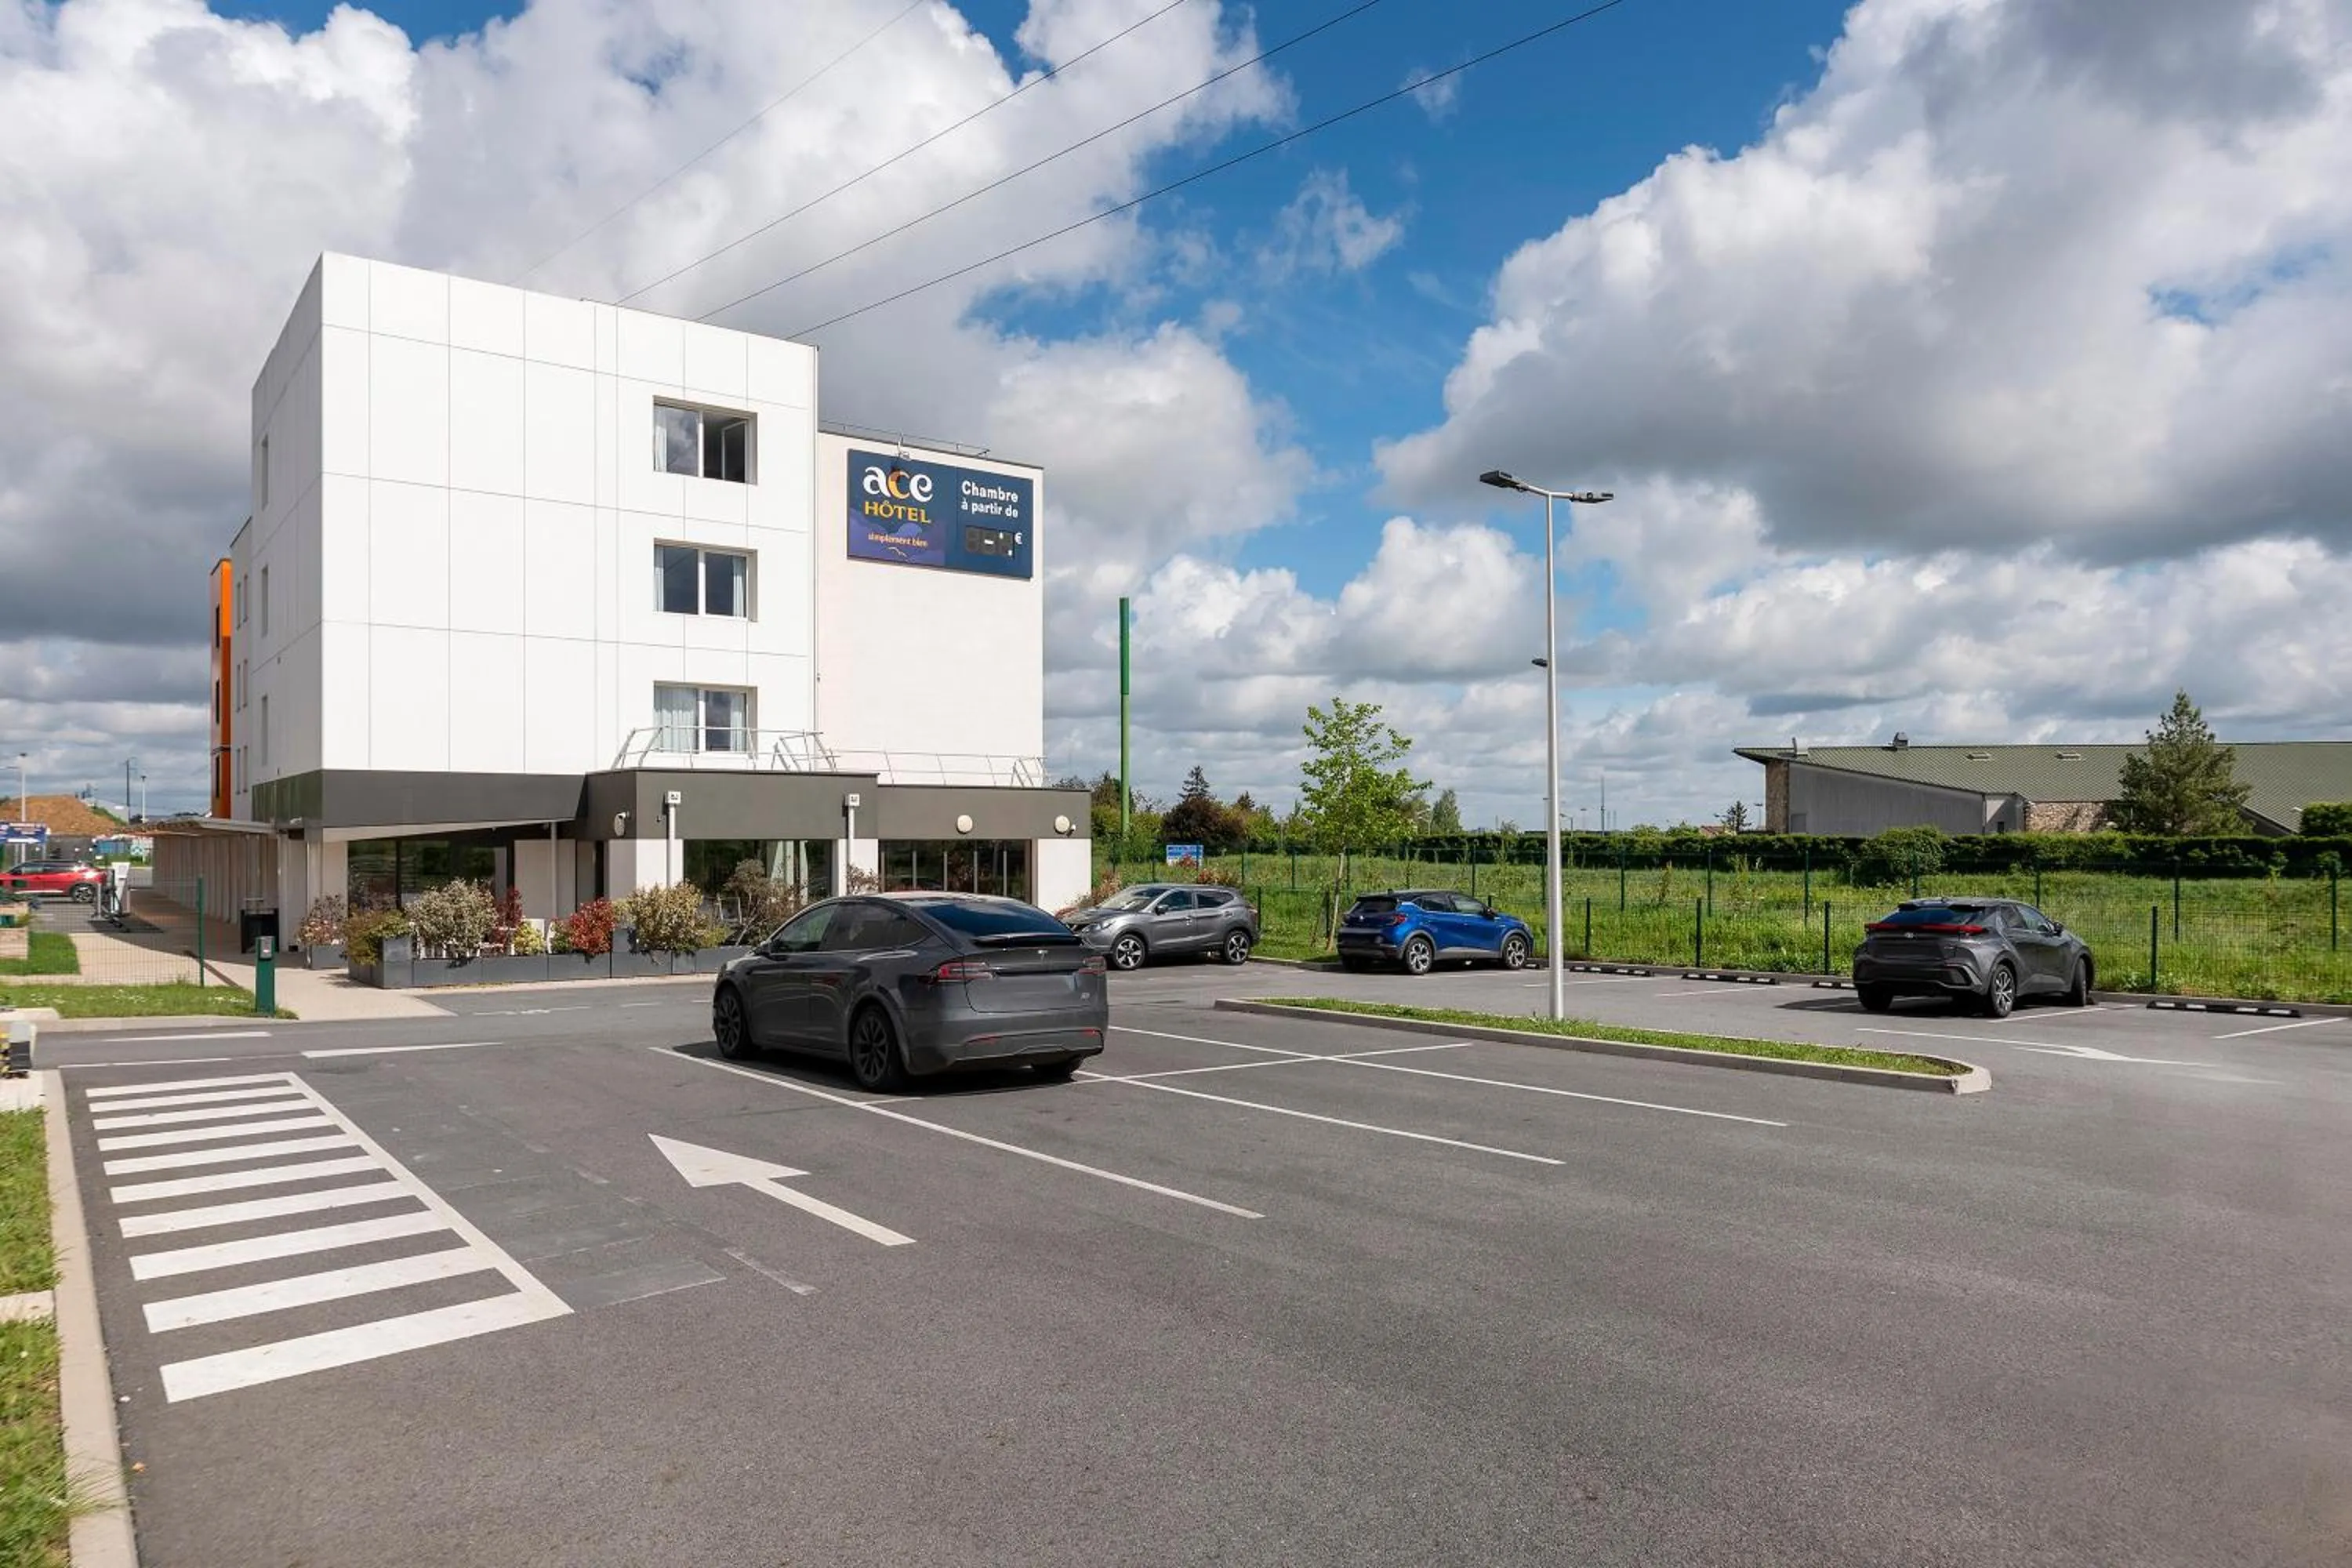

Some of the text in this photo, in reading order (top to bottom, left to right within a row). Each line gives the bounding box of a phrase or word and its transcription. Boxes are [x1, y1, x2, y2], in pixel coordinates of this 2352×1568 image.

[863, 466, 933, 502] ace
[961, 480, 1018, 502] Chambre
[865, 500, 931, 523] HÔTEL
[961, 497, 1018, 518] à partir de
